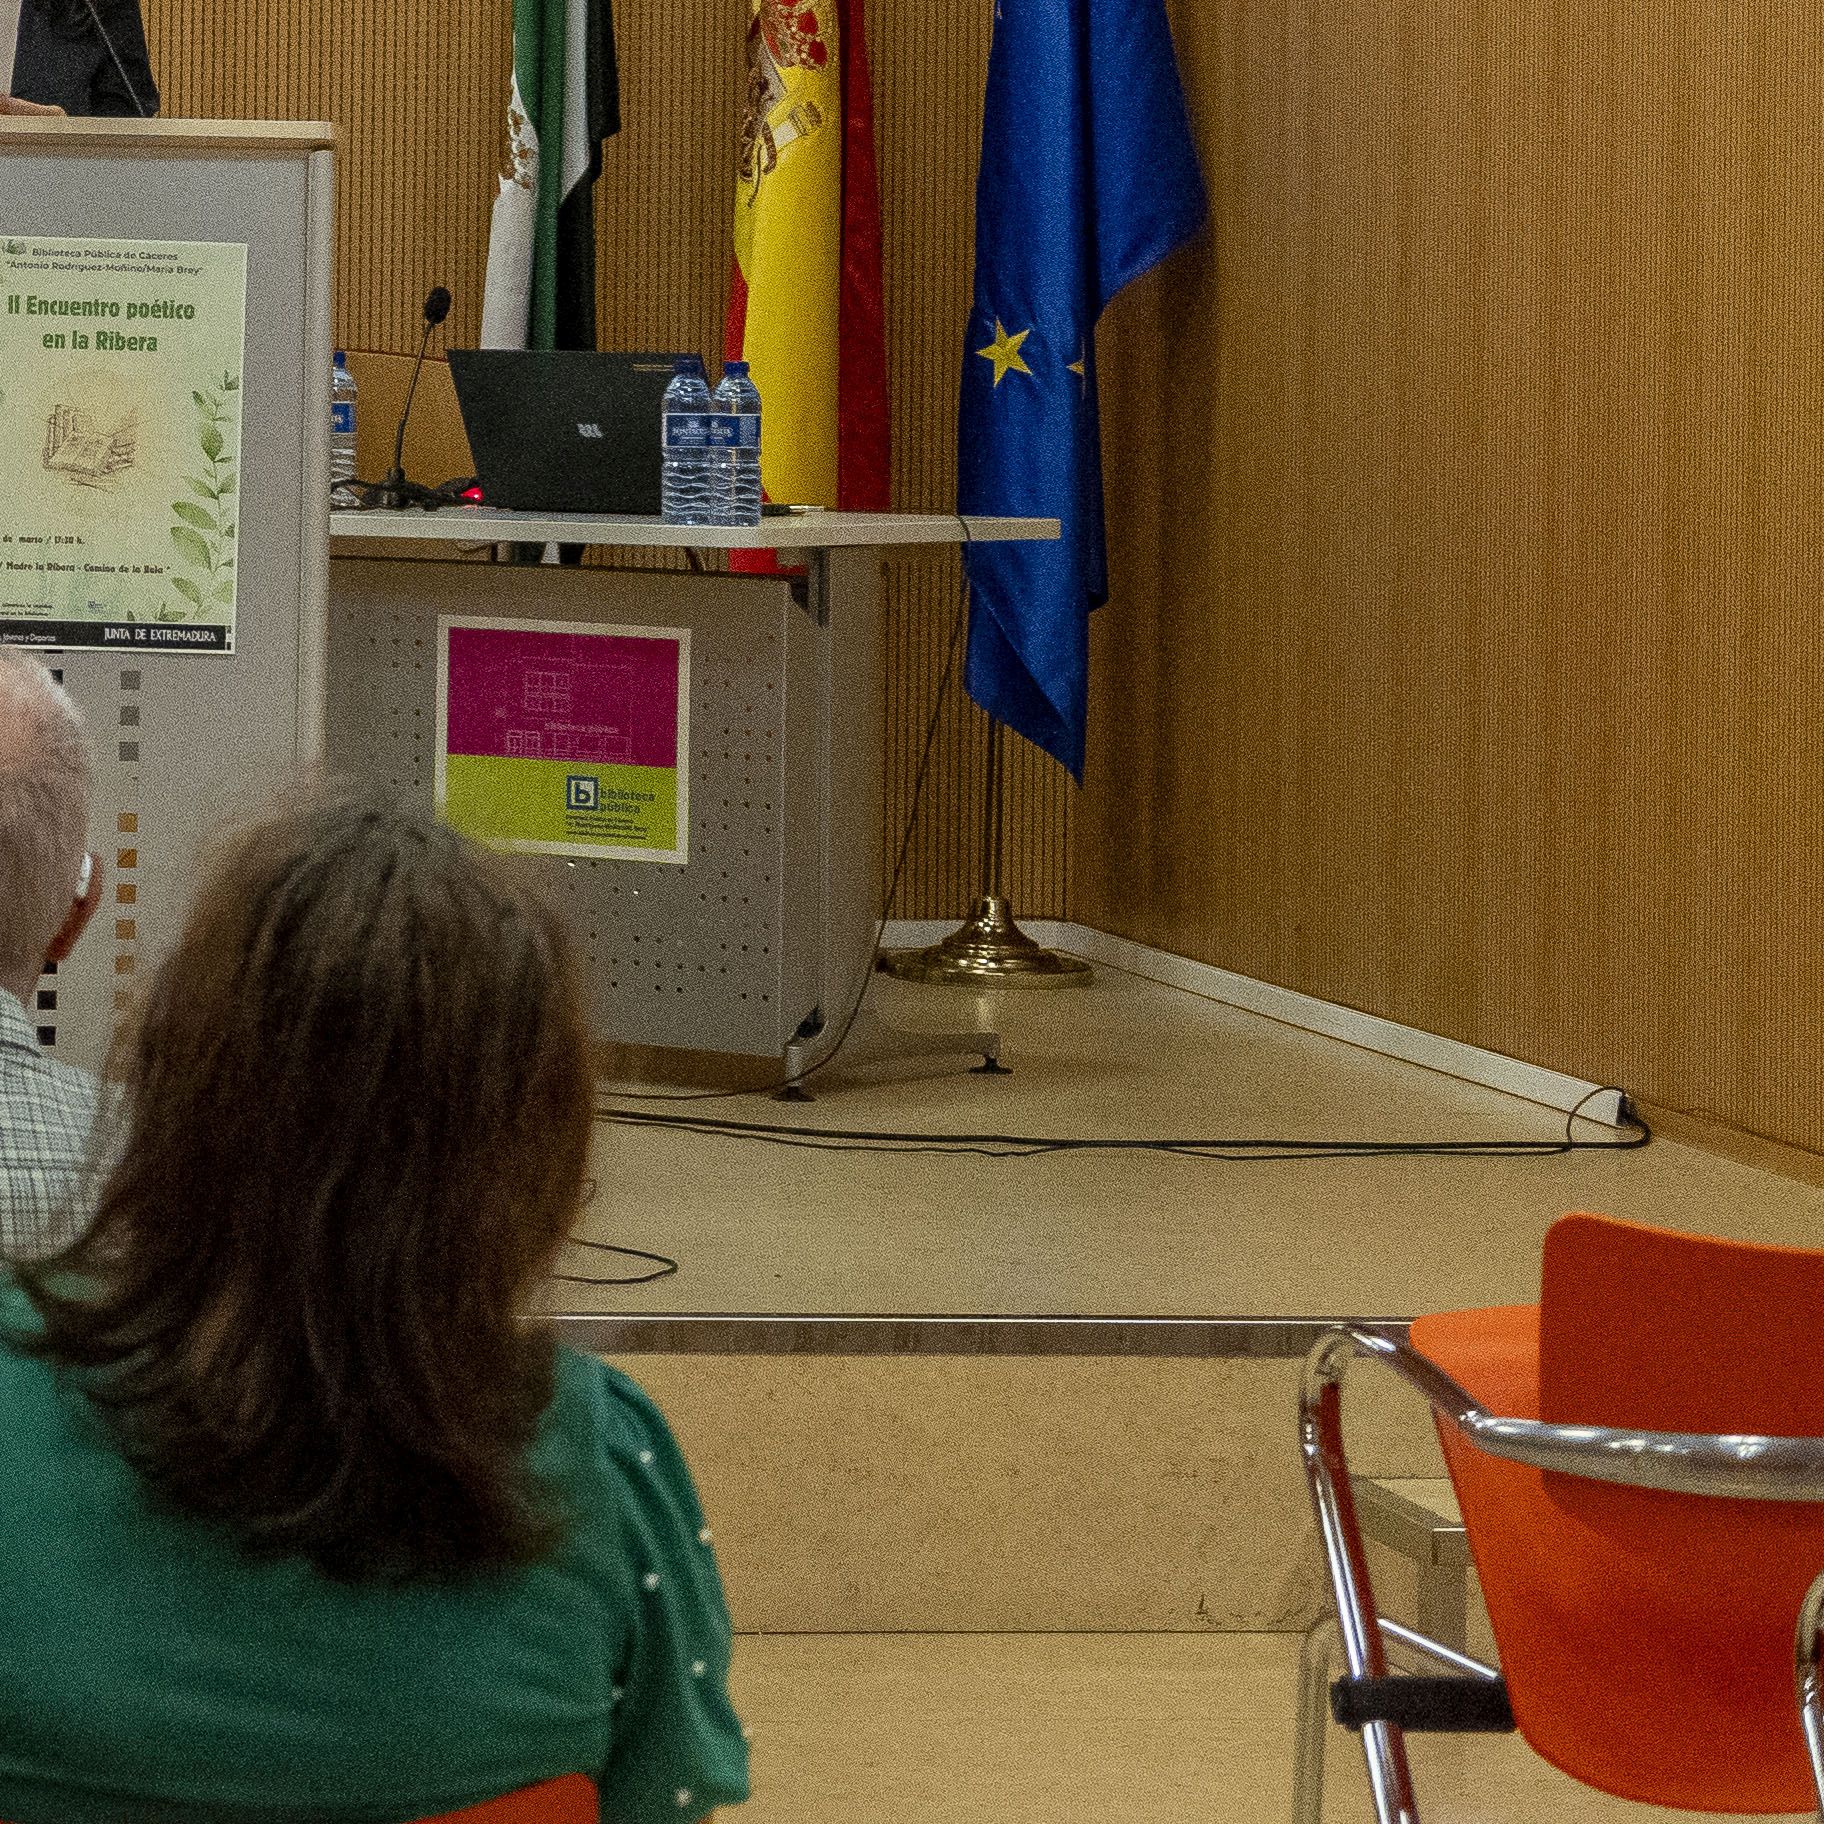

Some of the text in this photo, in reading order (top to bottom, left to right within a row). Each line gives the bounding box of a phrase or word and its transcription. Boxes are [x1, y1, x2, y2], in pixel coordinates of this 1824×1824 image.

[32, 248, 81, 258] Biblioteca
[123, 250, 136, 259] de
[8, 295, 196, 320] II Encuentro poético
[42, 330, 158, 351] en la Ribera
[105, 627, 216, 642] JUNTA DE EXTREMADURA
